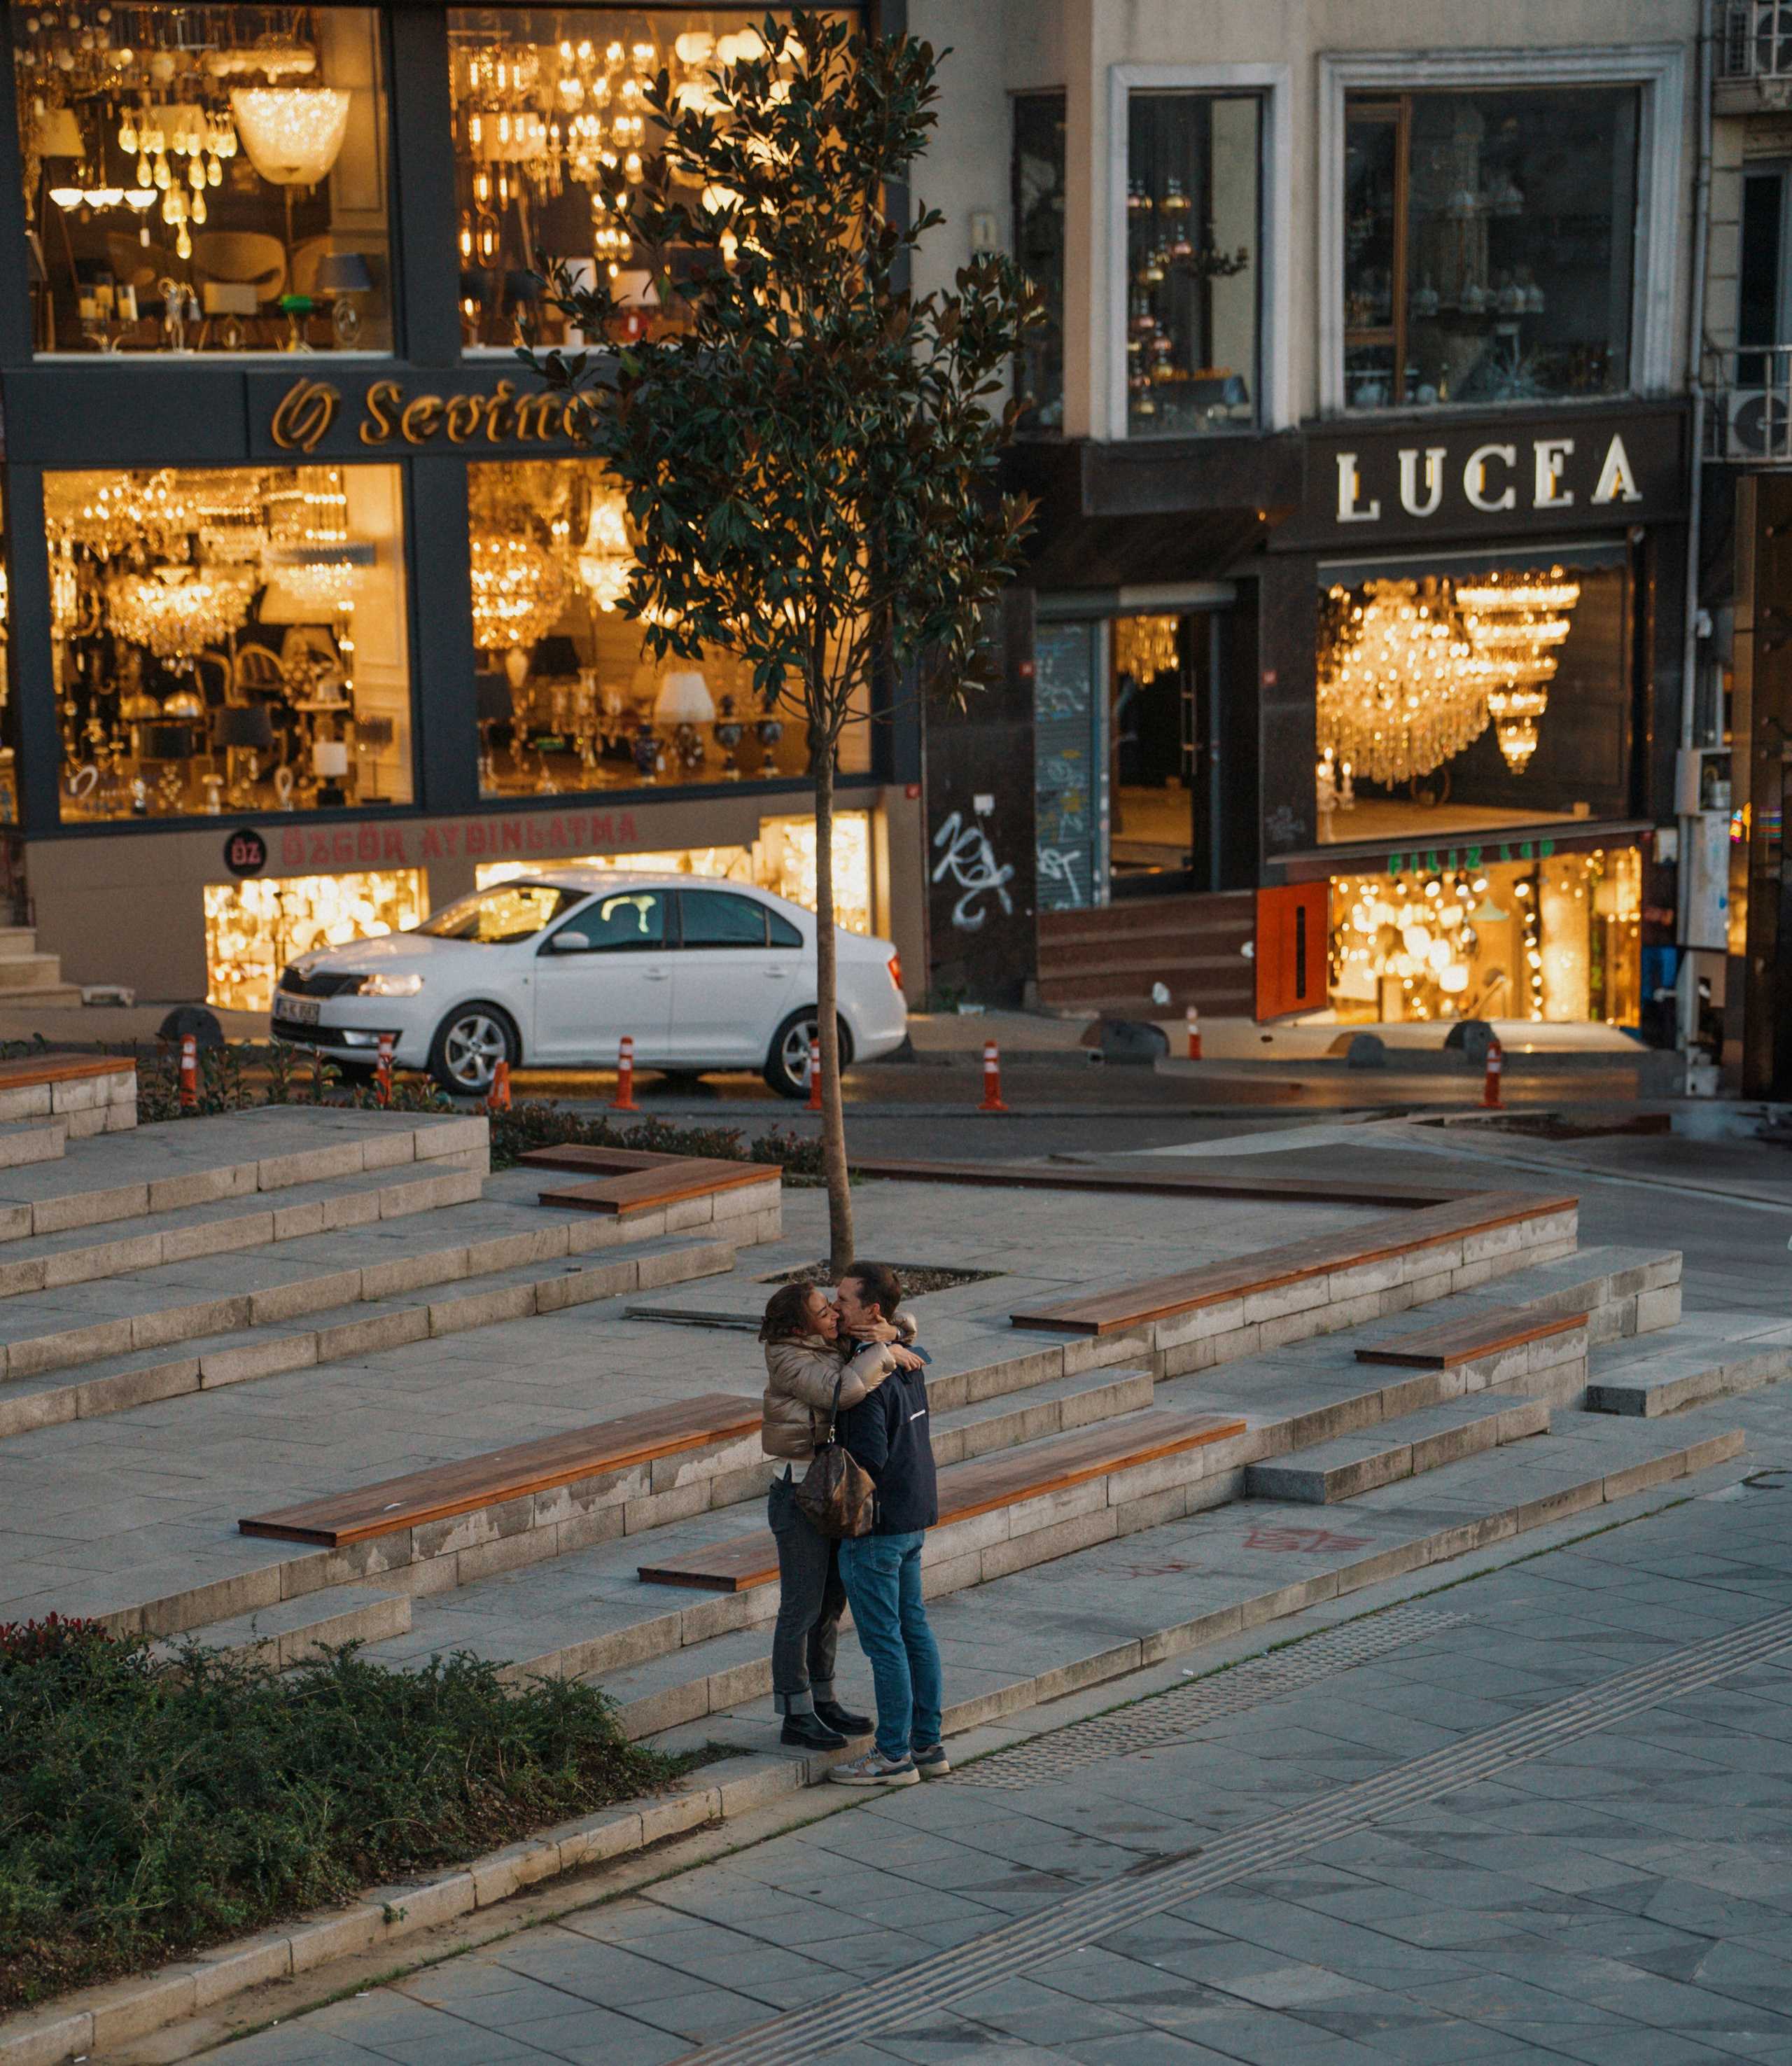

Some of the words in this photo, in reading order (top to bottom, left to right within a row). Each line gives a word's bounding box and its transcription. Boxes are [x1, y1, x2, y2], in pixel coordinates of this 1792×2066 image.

[1336, 432, 1643, 523] LUCEA
[232, 837, 261, 865] ÖZ
[421, 813, 638, 858] AYDINLATMA
